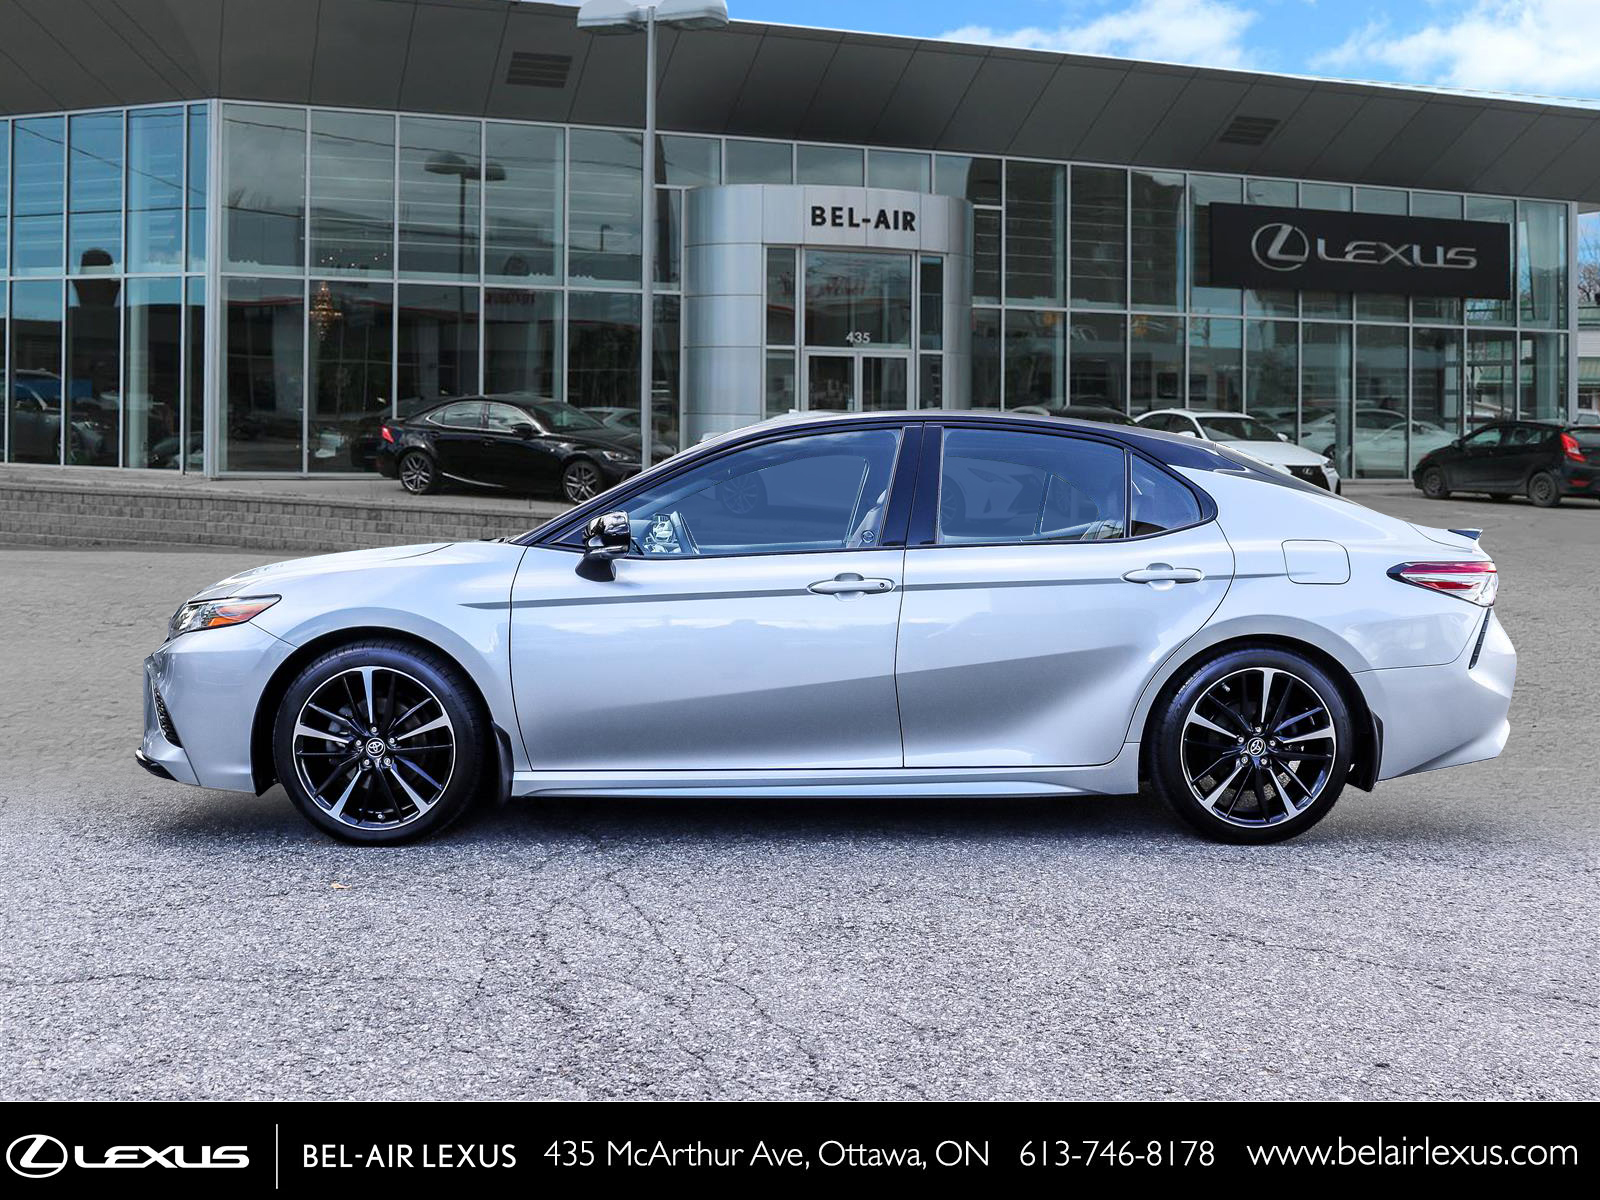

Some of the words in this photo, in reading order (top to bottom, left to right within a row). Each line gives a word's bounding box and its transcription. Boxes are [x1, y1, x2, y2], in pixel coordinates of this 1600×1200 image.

[810, 205, 916, 232] BEL-AIR
[1317, 238, 1477, 269] LEXUS
[846, 331, 871, 344] 435
